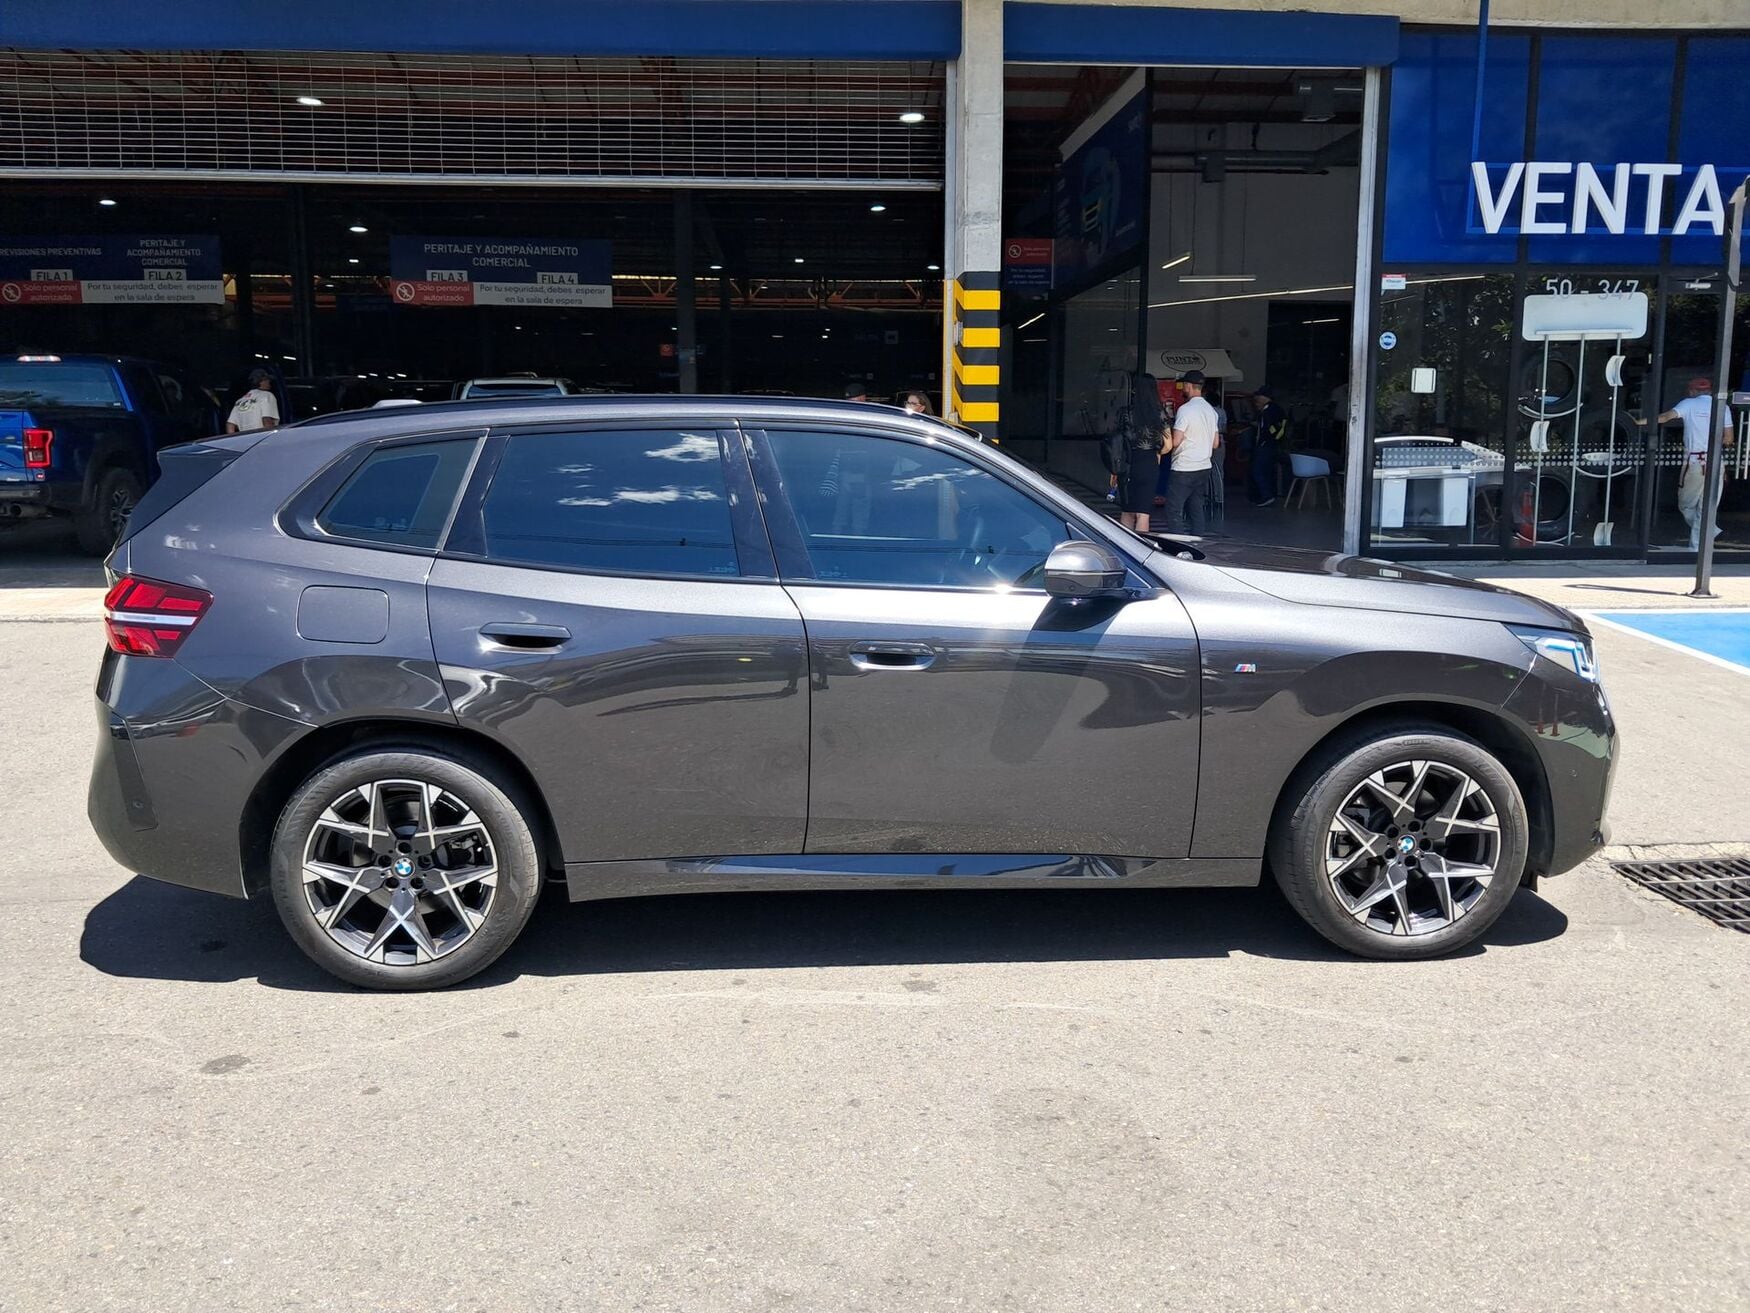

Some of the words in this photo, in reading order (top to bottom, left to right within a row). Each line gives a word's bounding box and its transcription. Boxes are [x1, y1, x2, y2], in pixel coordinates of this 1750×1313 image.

[1471, 161, 1725, 236] VENTA
[139, 239, 179, 248] PERITAJE
[180, 239, 186, 248] Y
[47, 247, 102, 257] PREVENTIVAS
[126, 247, 201, 257] ACOMPAÑAMIENTO
[424, 243, 473, 255] PERITAJE
[474, 244, 482, 254] Y
[484, 243, 579, 256] ACOMPAÑAMIENTO
[141, 258, 188, 267] COMERCIAL
[472, 257, 532, 268] COMERCIAL
[36, 271, 62, 281] FILA
[63, 271, 68, 281] 1
[148, 271, 173, 281] FILA
[175, 271, 183, 281] 2
[431, 271, 455, 282] FILA
[458, 272, 464, 282] 3
[541, 274, 566, 284] FILA
[567, 275, 574, 285] 4
[87, 282, 101, 290] Por
[112, 282, 156, 292] seguridad,
[416, 283, 435, 292] Solo
[436, 283, 470, 293] personal
[479, 284, 492, 292] Por
[504, 285, 546, 295] seguridad,
[547, 286, 572, 294] debes
[575, 287, 606, 296] esperar
[1546, 279, 1572, 299] 50
[1598, 279, 1640, 300] 347
[127, 293, 135, 301] la
[136, 293, 152, 301] sala
[154, 293, 165, 301] de
[424, 294, 464, 302] autorizado
[526, 296, 542, 304] sala
[543, 296, 554, 304] de
[555, 297, 583, 306] espera
